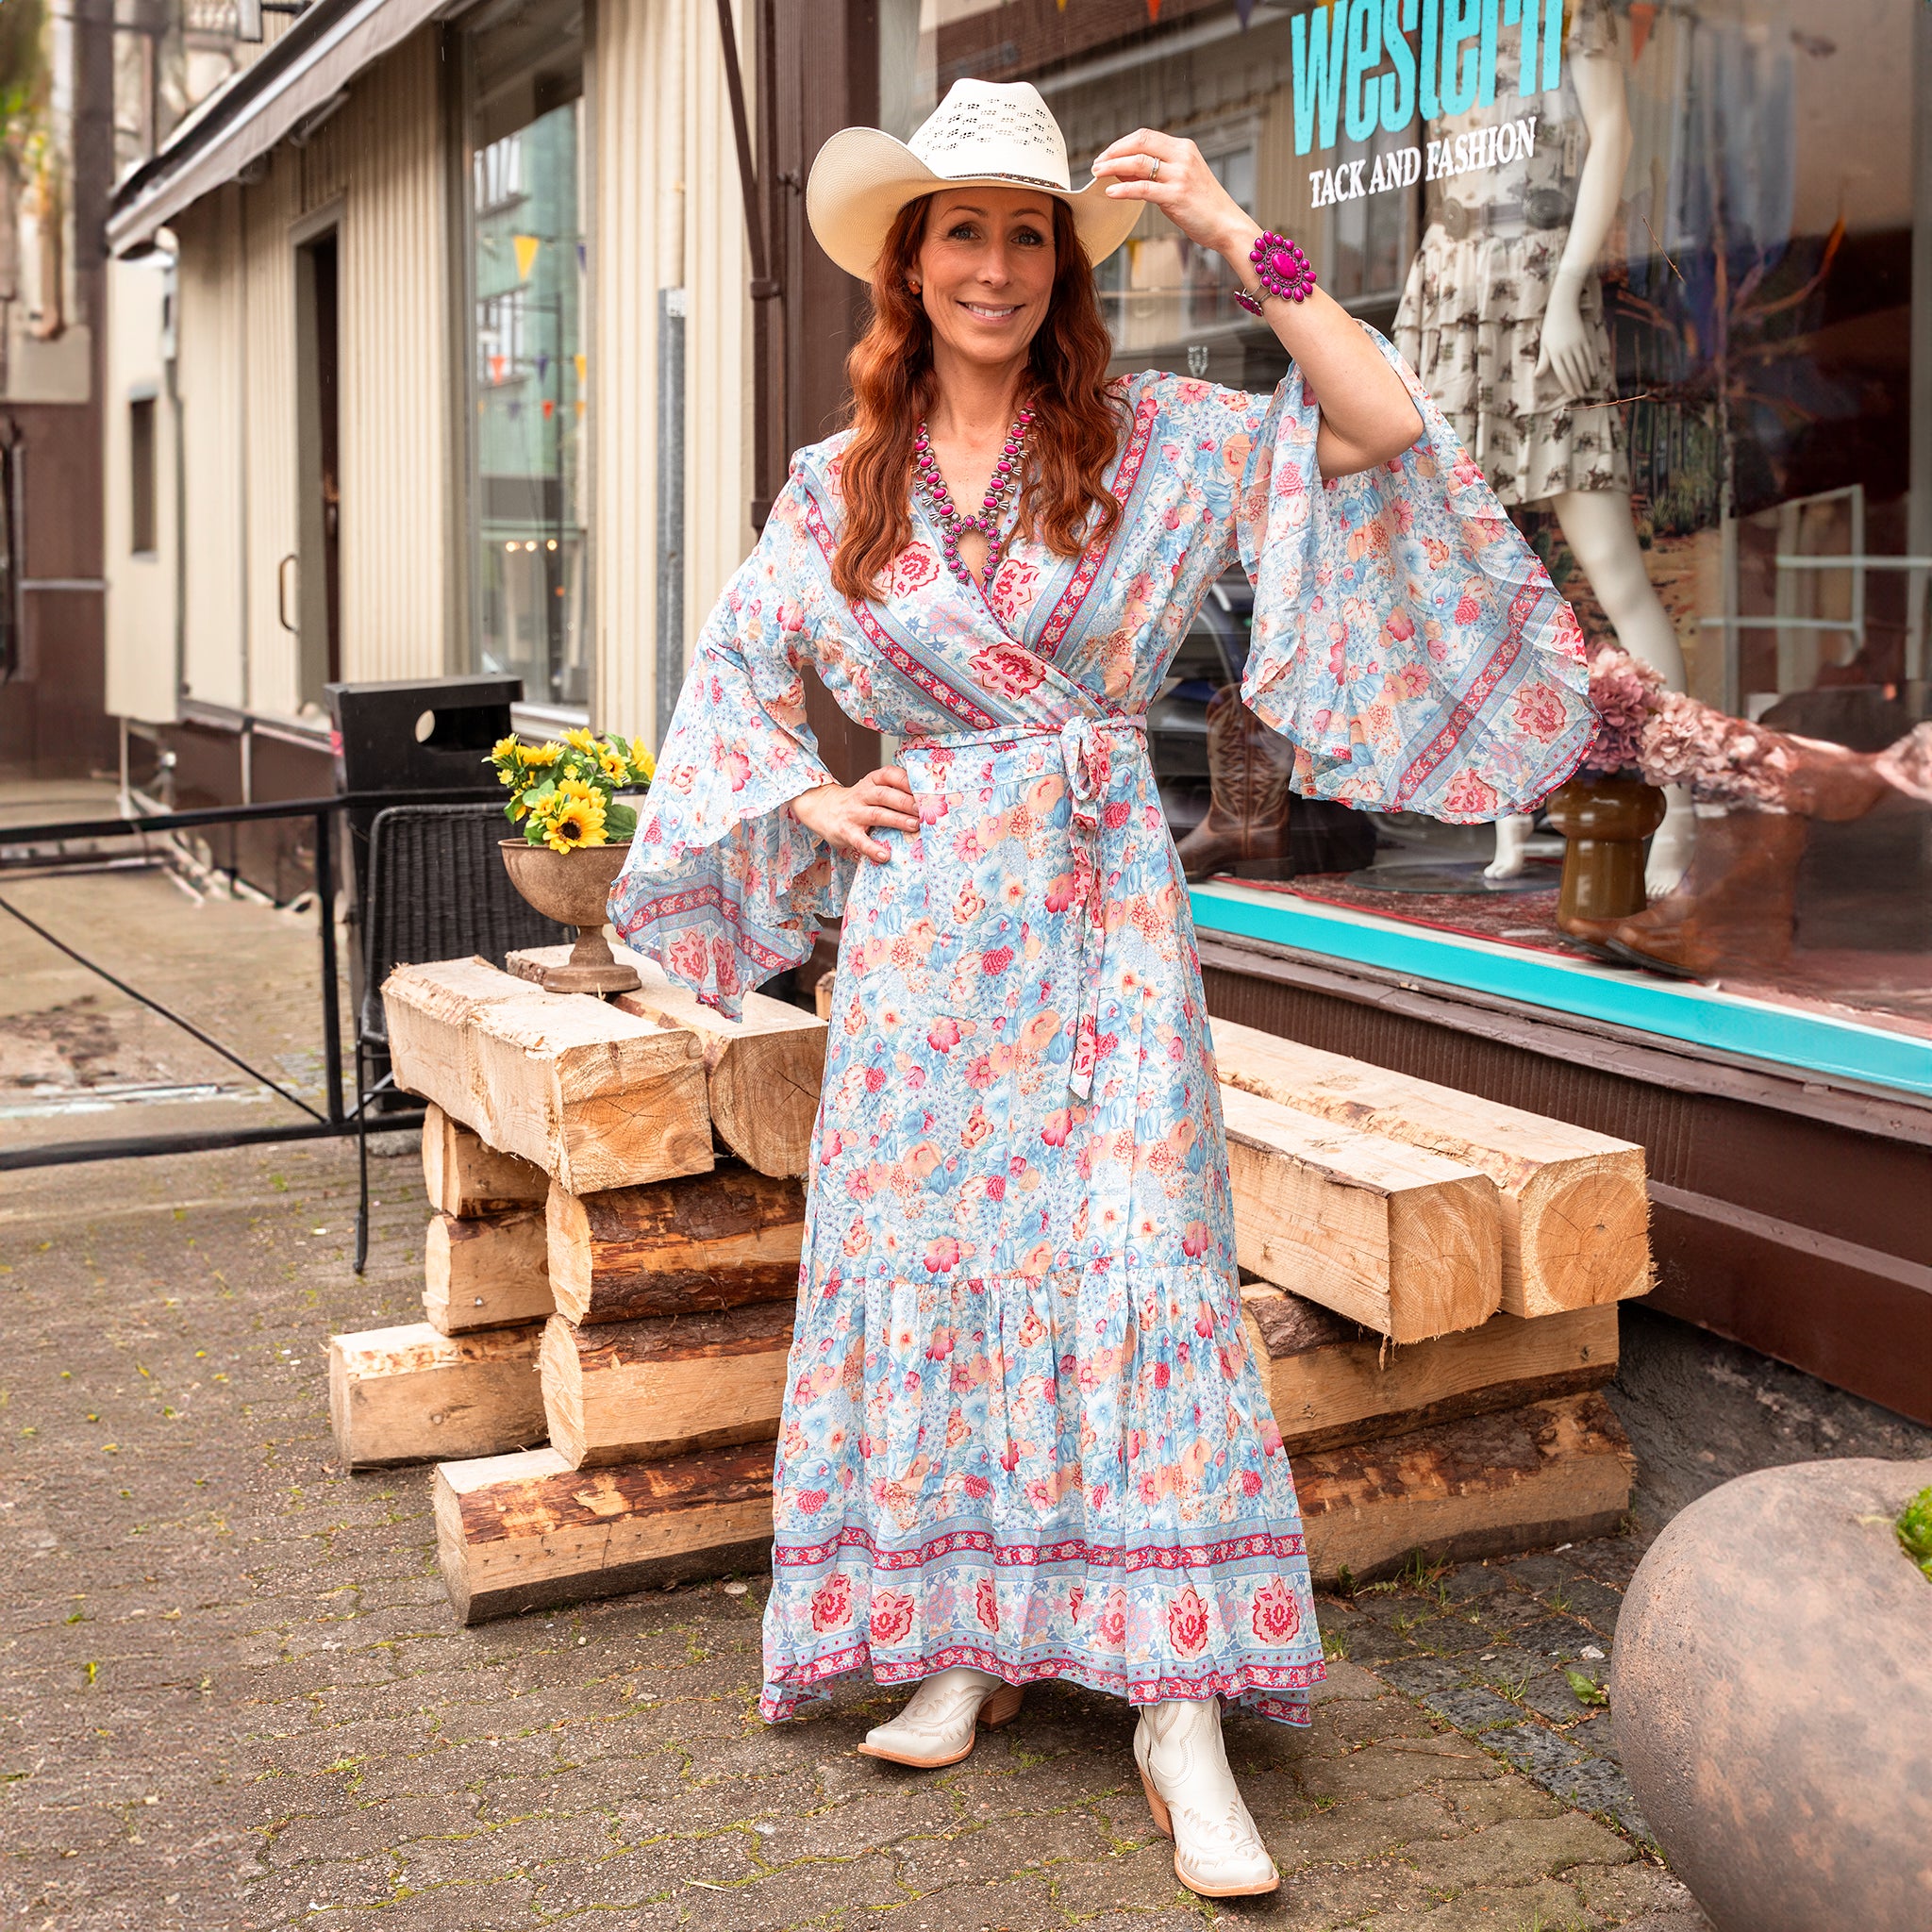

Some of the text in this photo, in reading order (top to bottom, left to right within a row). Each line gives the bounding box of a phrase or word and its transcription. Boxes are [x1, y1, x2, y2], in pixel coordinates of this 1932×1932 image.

[1309, 159, 1366, 208] TACK
[1368, 146, 1422, 194] AND
[1424, 116, 1537, 182] FASHION
